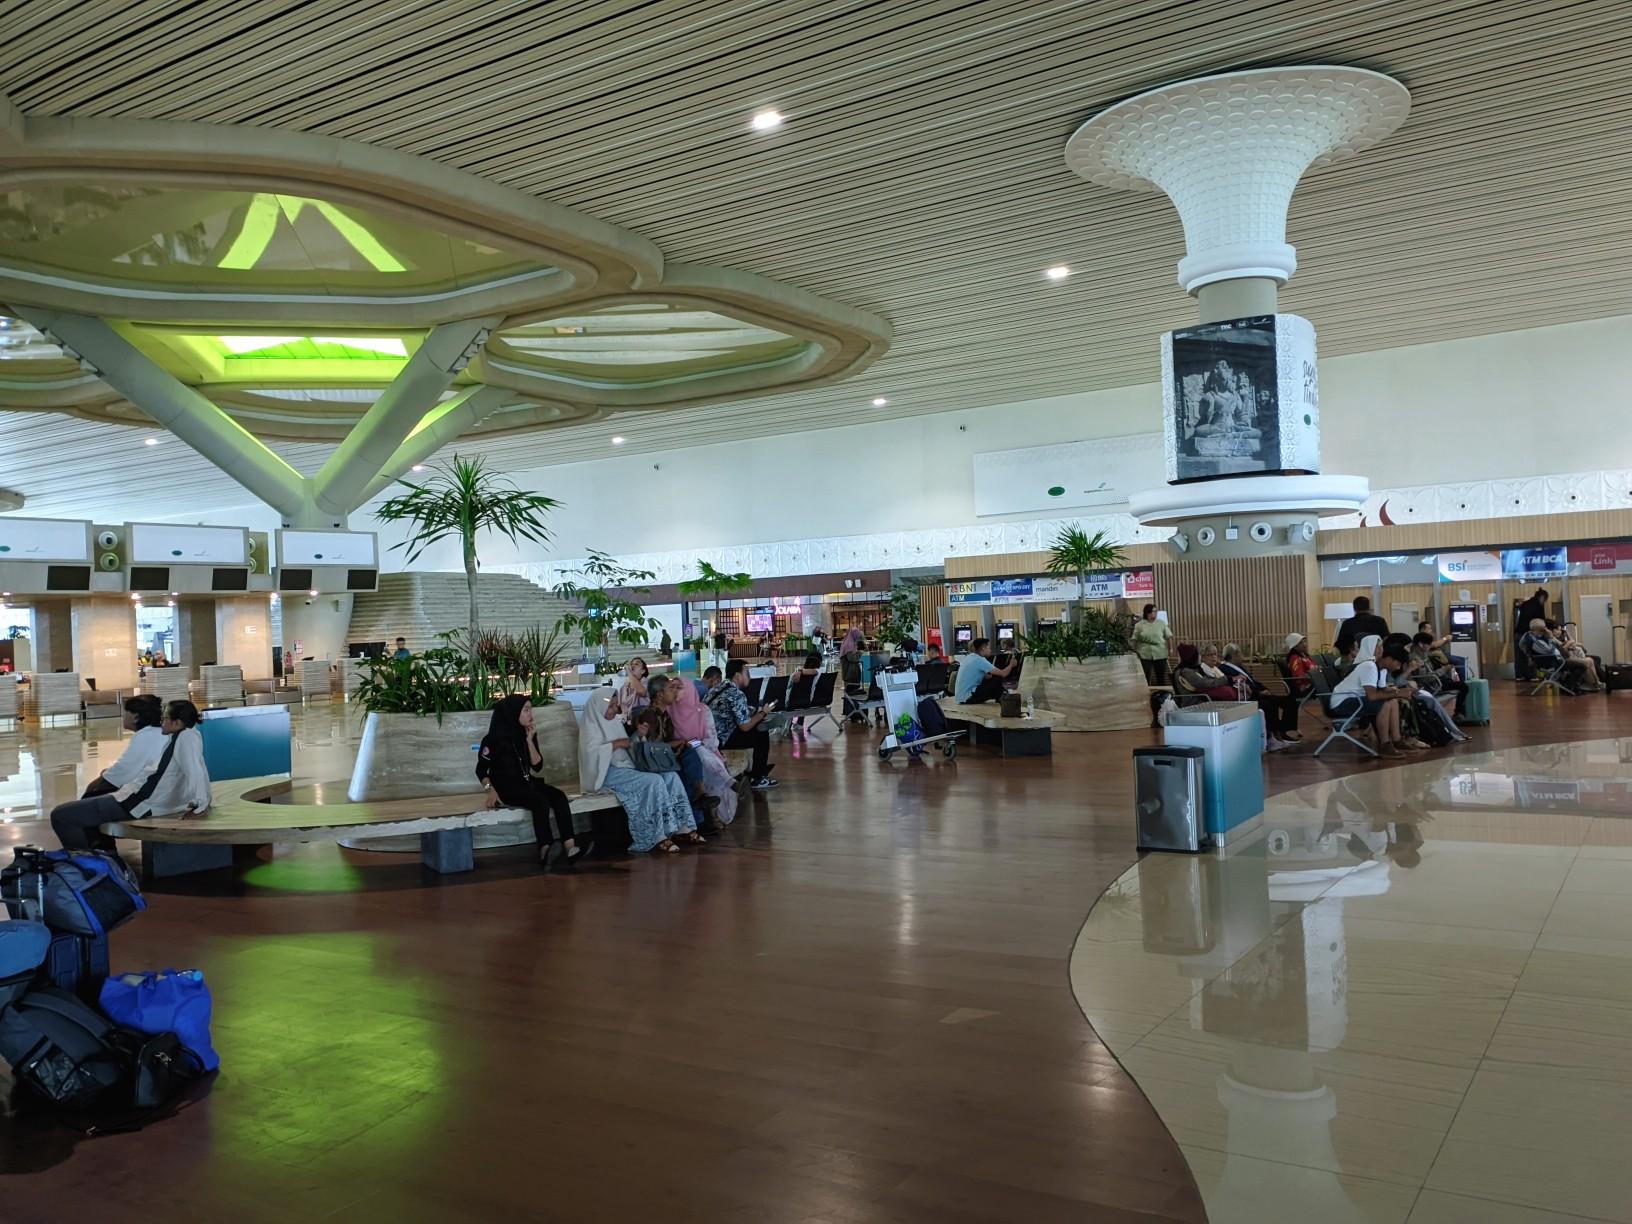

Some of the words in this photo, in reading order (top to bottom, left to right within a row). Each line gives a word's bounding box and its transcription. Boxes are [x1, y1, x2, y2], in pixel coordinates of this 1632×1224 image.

[1520, 556, 1541, 564] ATM
[1542, 555, 1563, 564] BCA
[1593, 557, 1614, 566] Link
[960, 583, 977, 593] BNI
[1091, 584, 1109, 592] ATM
[951, 594, 965, 602] ATM
